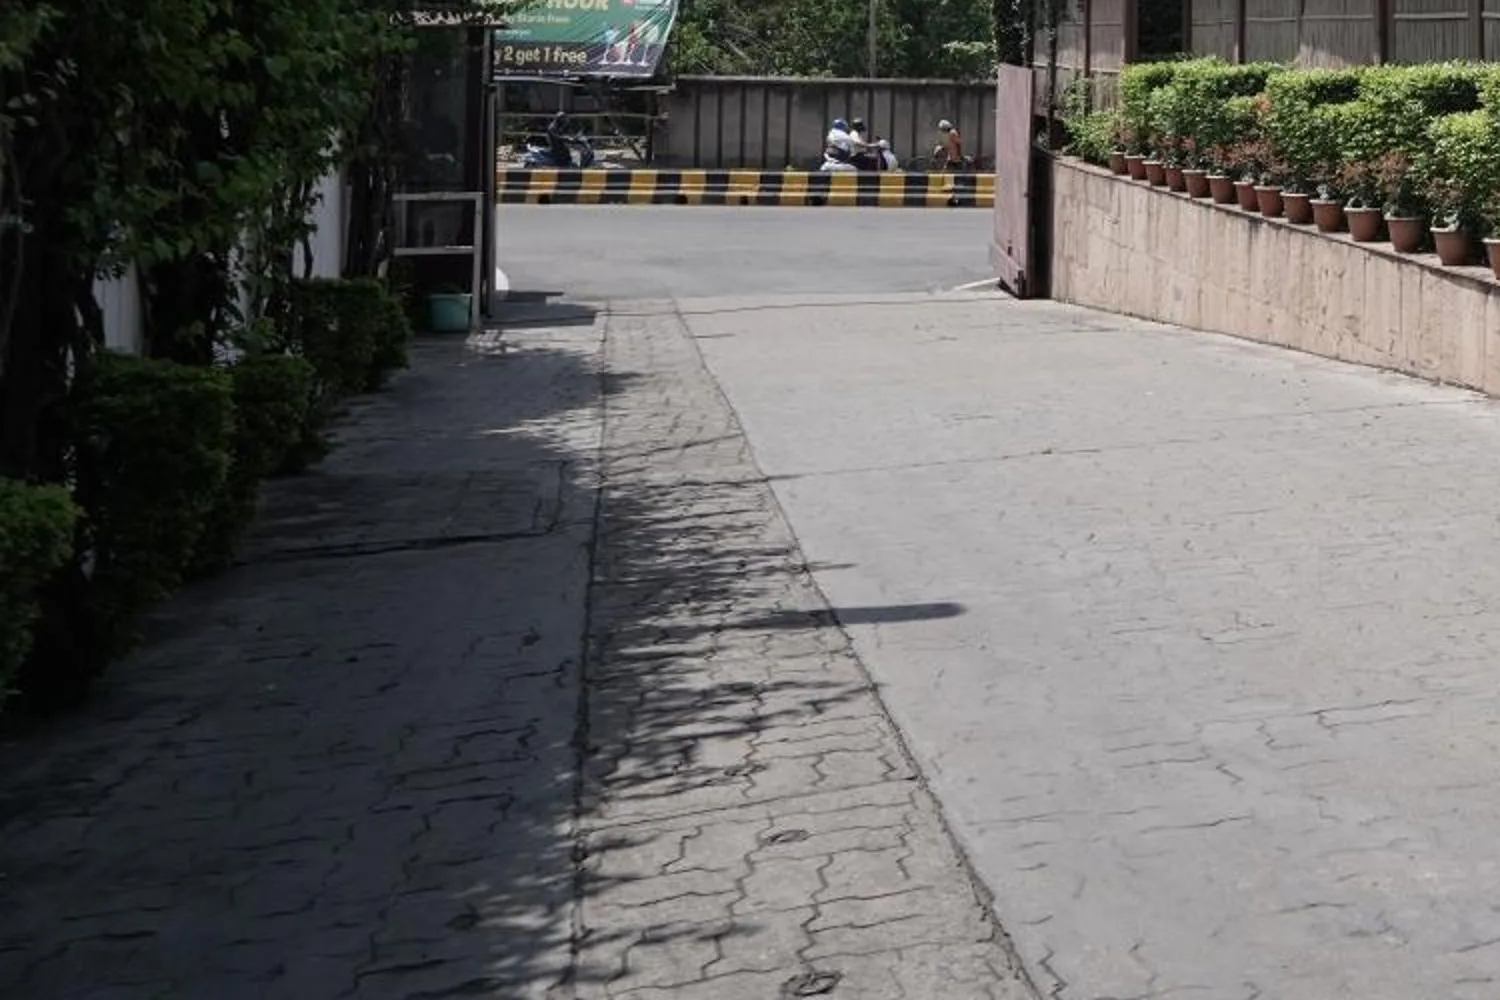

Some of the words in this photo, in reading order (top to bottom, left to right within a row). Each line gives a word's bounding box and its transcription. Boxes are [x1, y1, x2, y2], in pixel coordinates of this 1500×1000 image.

[503, 46, 513, 61] 2
[515, 47, 540, 65] get
[544, 47, 551, 62] 1
[552, 46, 588, 64] free
